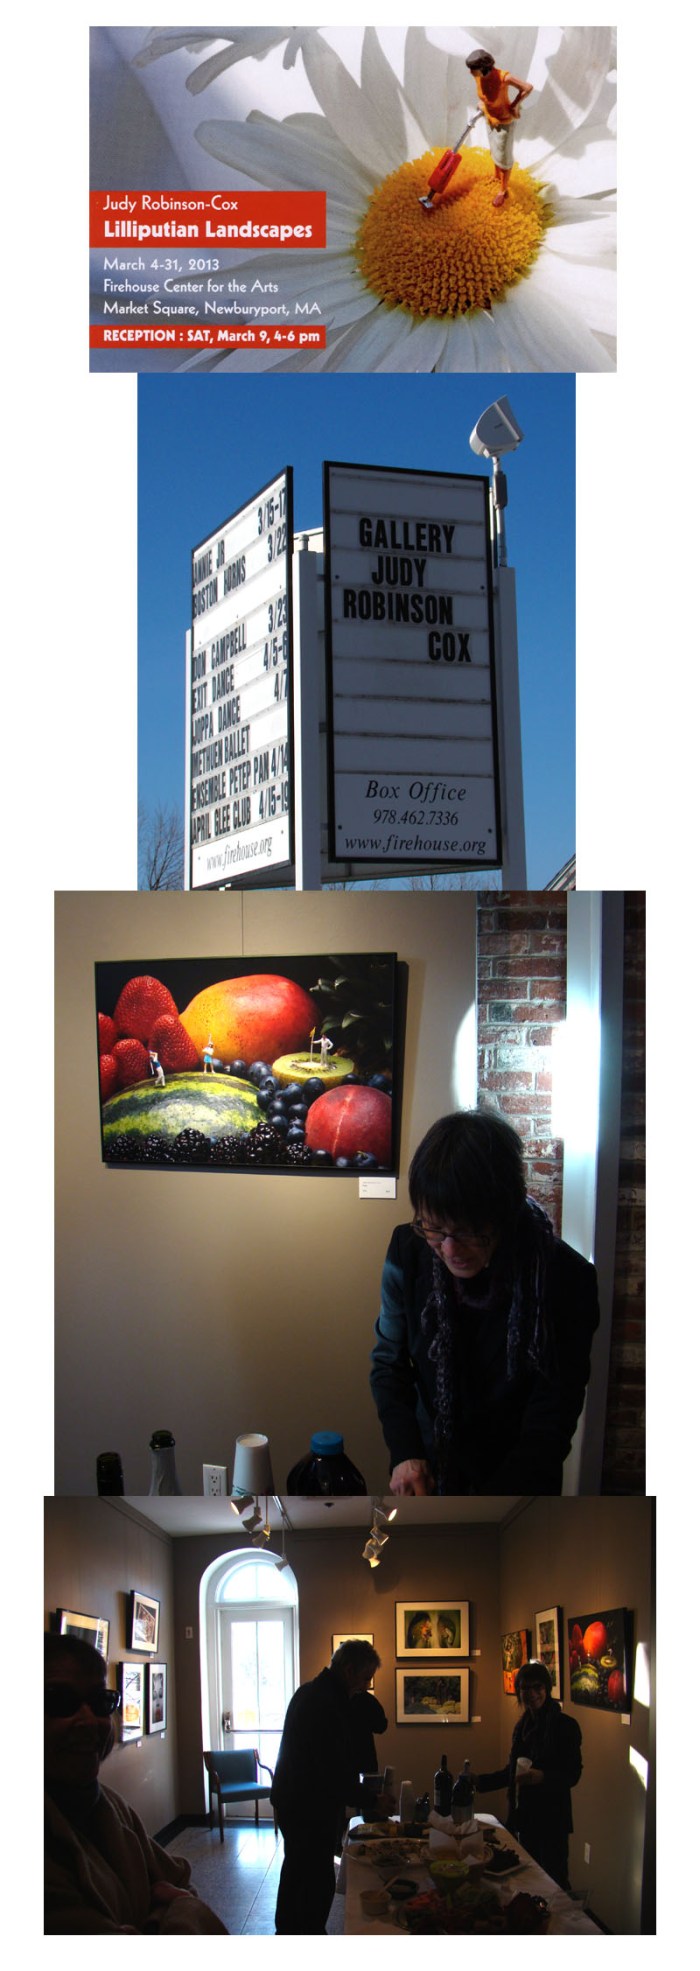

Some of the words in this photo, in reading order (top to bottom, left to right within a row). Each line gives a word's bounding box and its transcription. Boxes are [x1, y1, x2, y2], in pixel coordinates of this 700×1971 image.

[103, 195, 137, 213] Judy
[142, 195, 238, 210] Robinson-Cox
[104, 221, 198, 241] Lilliputian
[205, 221, 312, 241] Landscapes
[104, 257, 145, 270] March
[151, 259, 182, 272] 4-31,
[188, 259, 219, 270] 2013
[104, 279, 159, 292] Firehouse
[164, 279, 203, 292] Center
[207, 279, 224, 292] for
[228, 279, 246, 292] the
[251, 280, 278, 292] Arts
[103, 301, 148, 314] Market
[153, 301, 199, 317] Square,
[204, 301, 289, 317] Newburyport,
[295, 302, 321, 314] MA
[103, 330, 175, 341] RECEPTION
[187, 330, 213, 343] SAT,
[218, 330, 255, 342] March
[260, 331, 270, 343] 9,
[274, 332, 294, 341] 4-6
[299, 333, 320, 343] pm
[359, 517, 455, 553] GALLERY
[372, 555, 427, 587] JUDY
[193, 577, 217, 618] BOSTON
[343, 589, 453, 625] ROBINSON
[211, 623, 246, 669] CAMPBELL
[428, 631, 471, 662] COX
[192, 682, 207, 714] EXIT
[212, 664, 234, 702] DANCE
[218, 695, 240, 733] DANCE
[225, 724, 250, 763] BALLET
[192, 772, 226, 812] ENSEMBLE
[254, 751, 269, 785] PAN
[365, 780, 400, 800] Box
[408, 781, 466, 802] Office
[192, 813, 211, 844] APRIL
[215, 804, 230, 836] GLEE
[233, 796, 251, 829] CLUB
[373, 810, 458, 826] 978.462.7336
[206, 836, 272, 871] www.firehouse.org
[344, 835, 486, 855] www.firehouse.org
